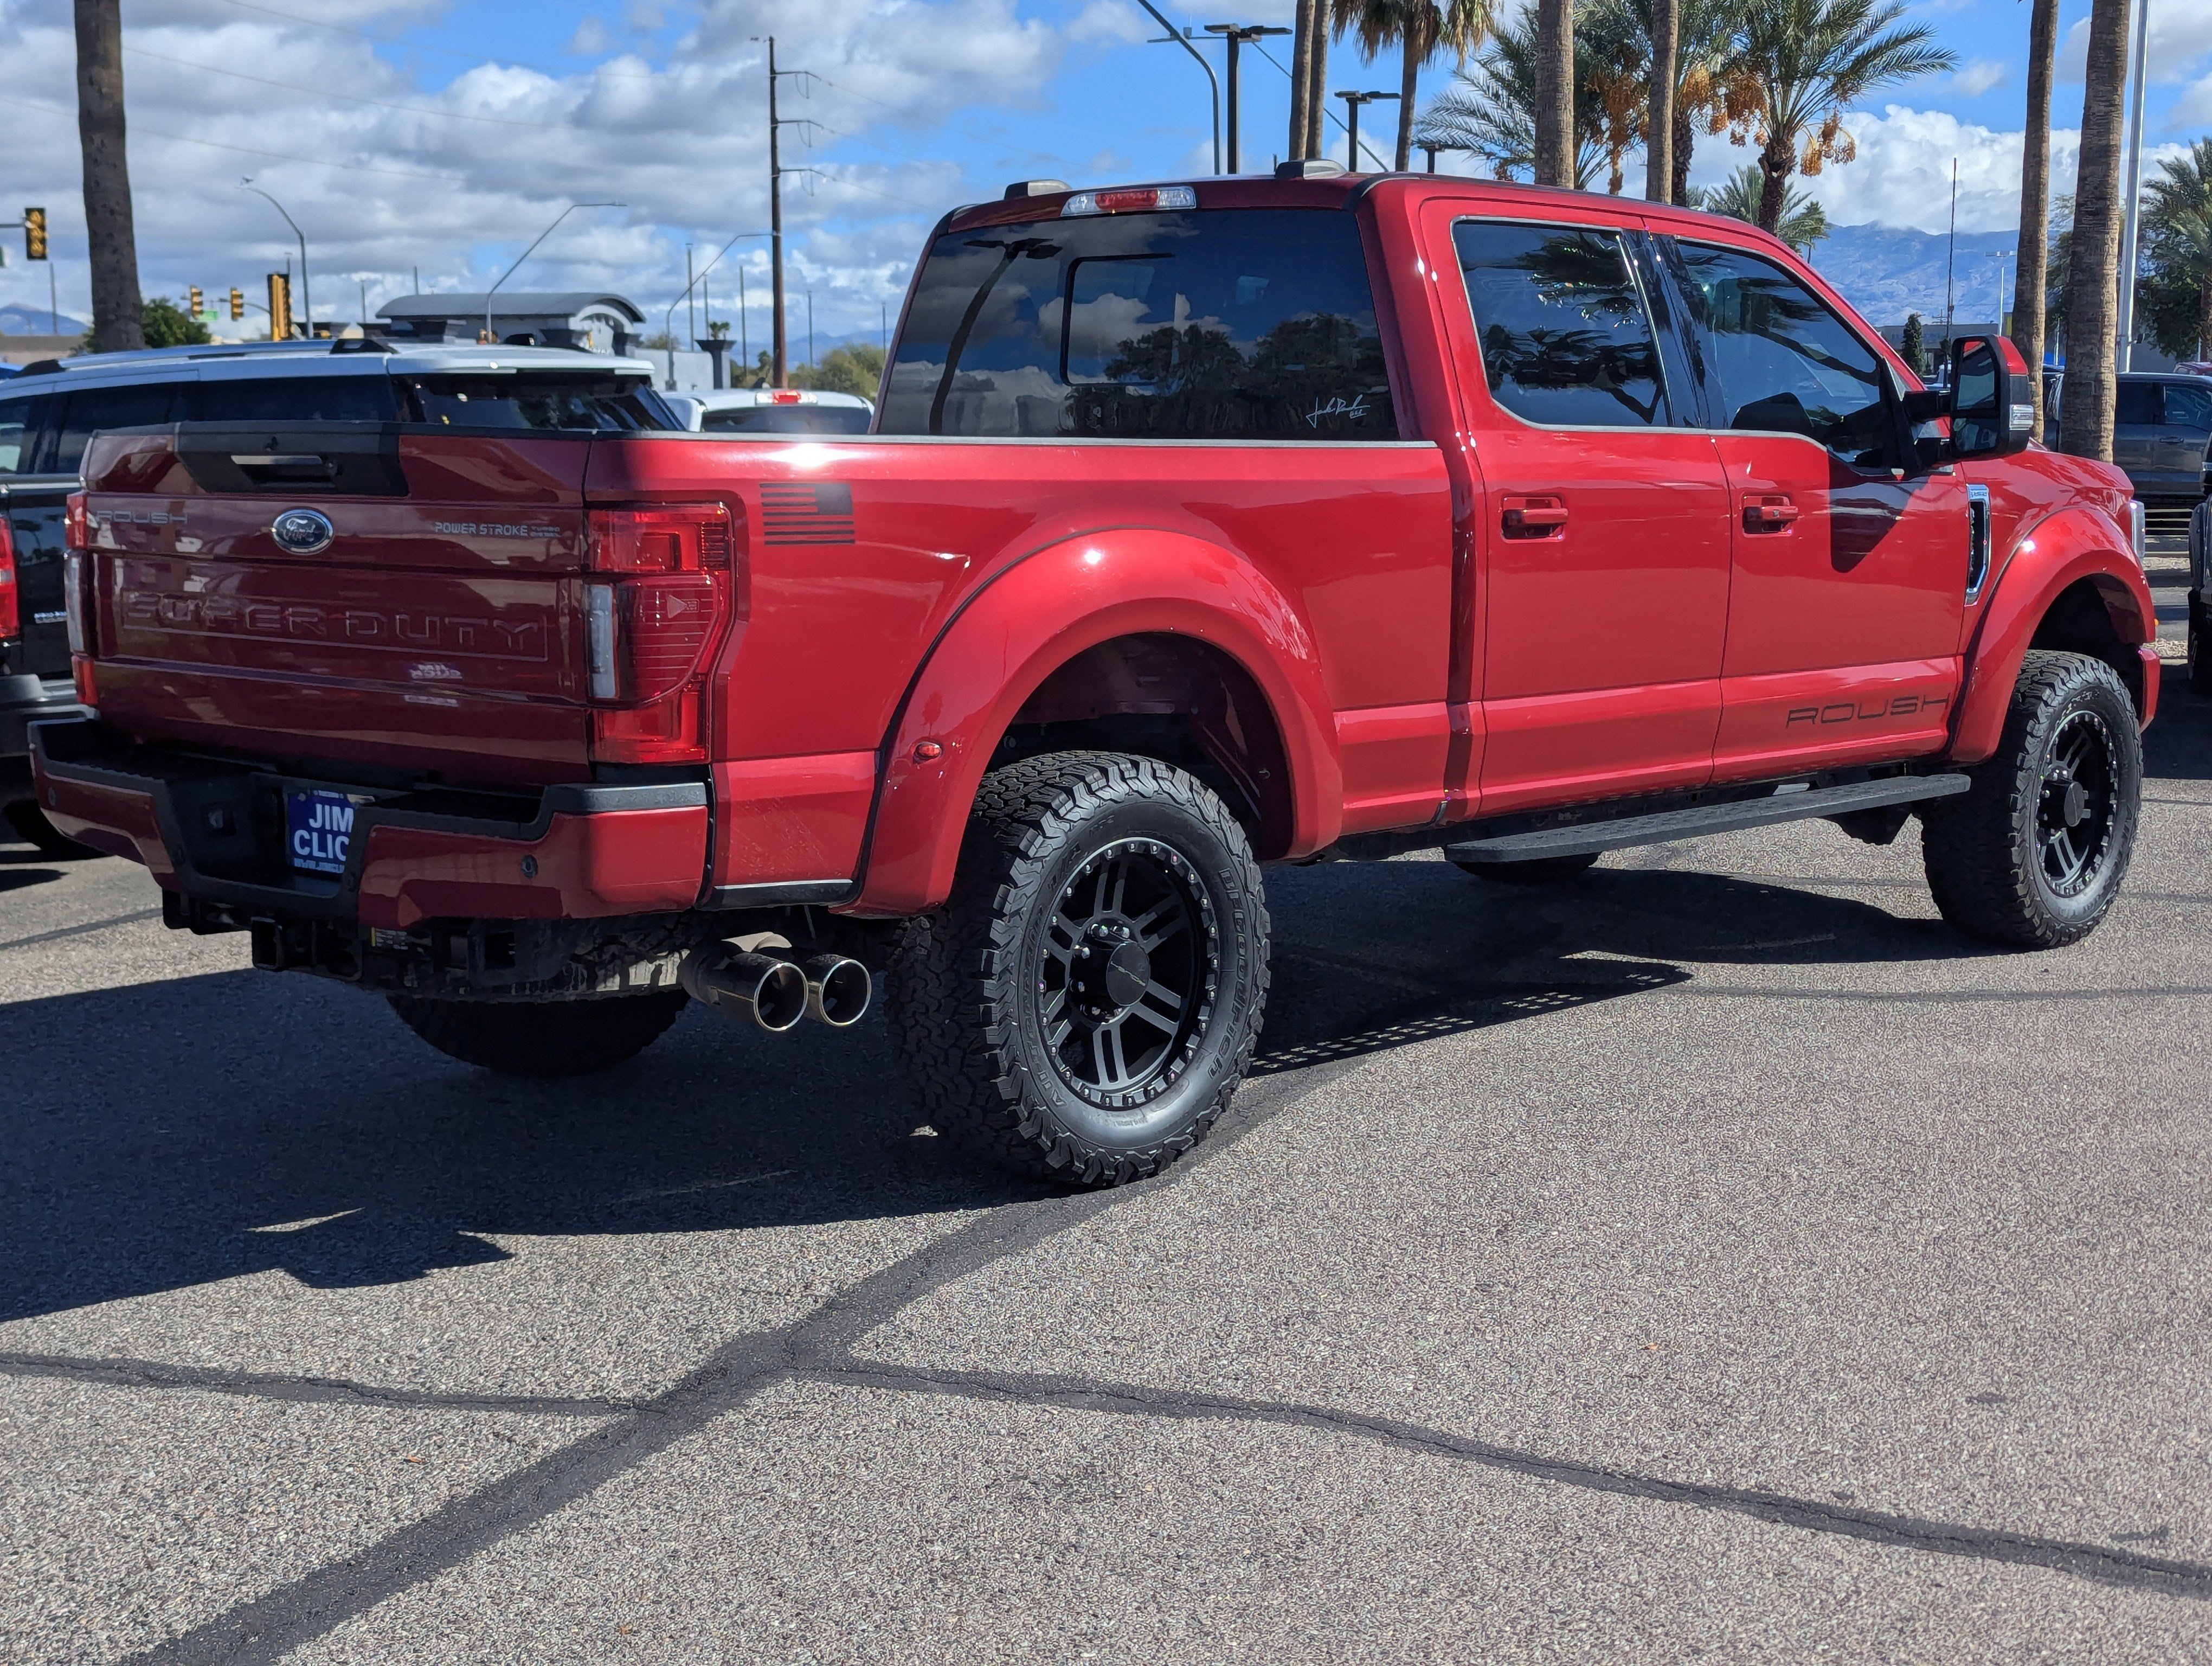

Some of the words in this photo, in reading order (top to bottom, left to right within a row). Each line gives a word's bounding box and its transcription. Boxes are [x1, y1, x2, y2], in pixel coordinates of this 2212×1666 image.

[94, 510, 188, 525] ROUSH
[435, 521, 477, 535] POWER
[479, 523, 529, 537] STROKE
[127, 592, 326, 635] SUPER
[345, 610, 539, 651] DUTY
[1785, 693, 1951, 729] ROUSH
[308, 803, 354, 833] JIM
